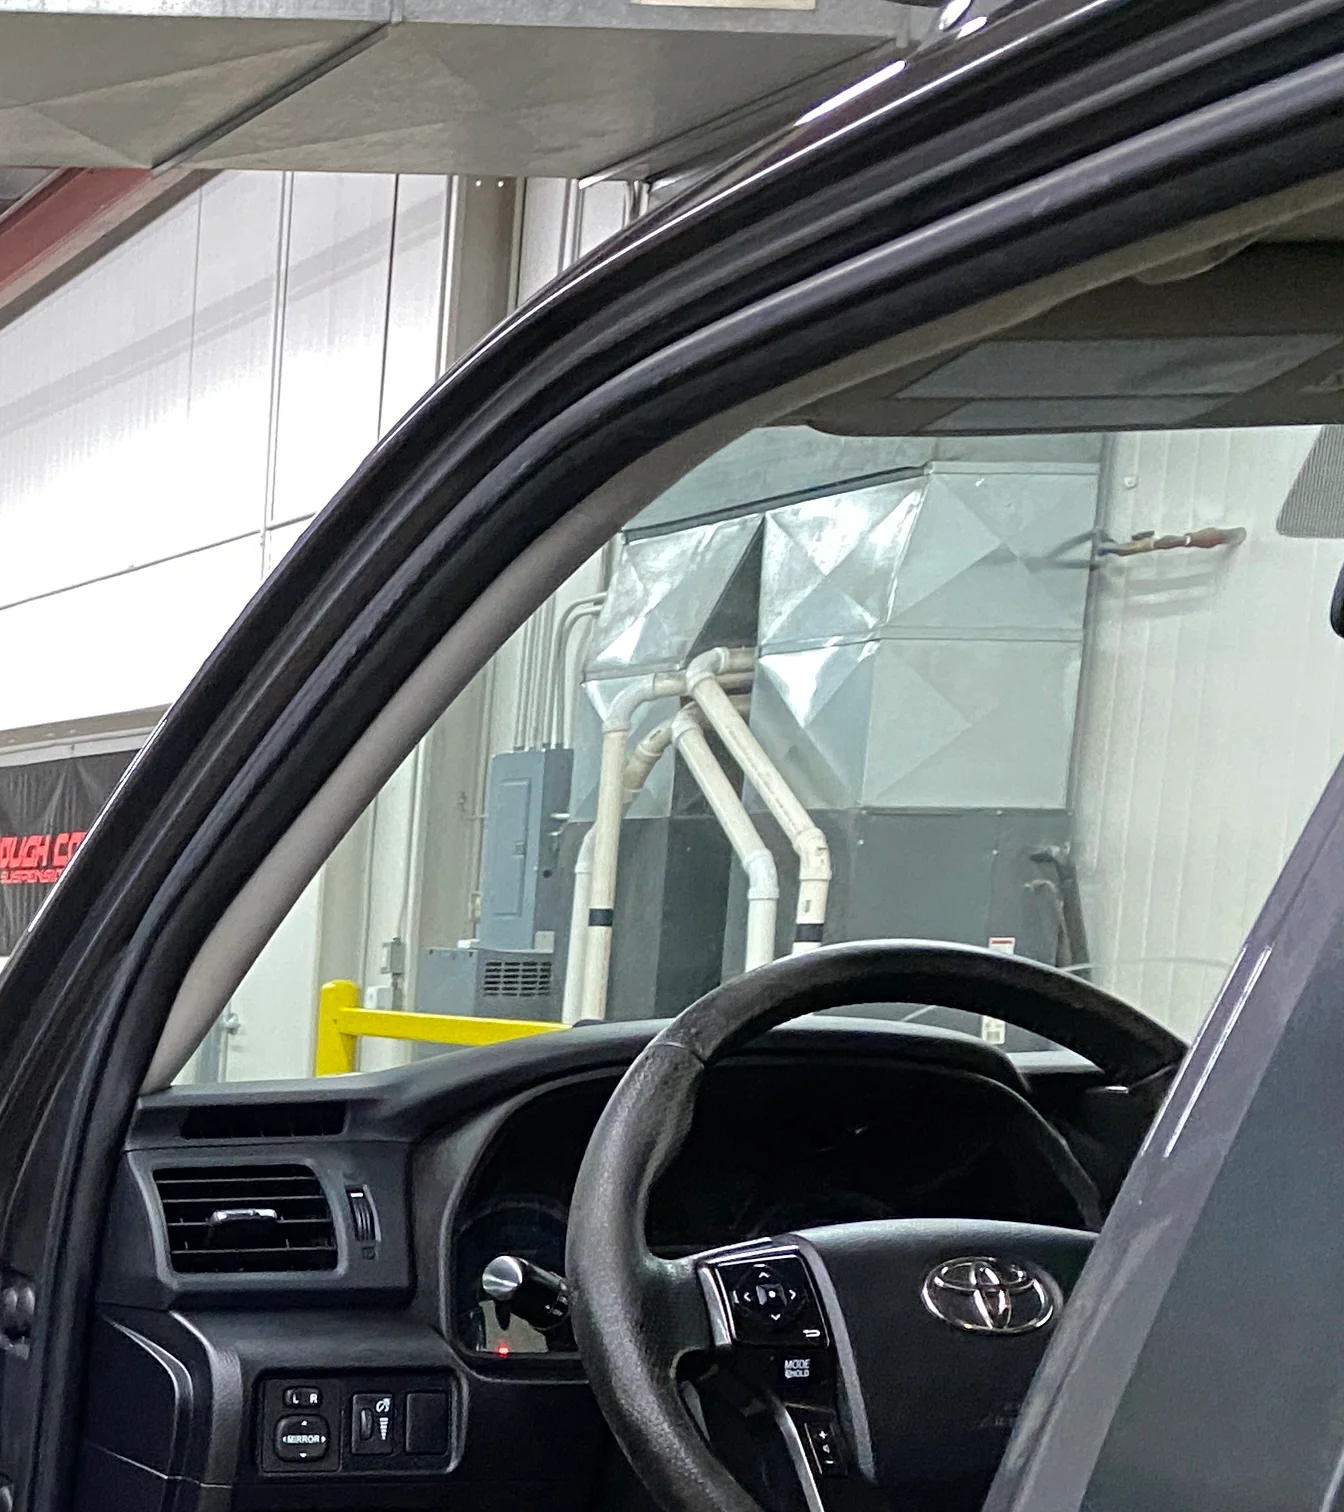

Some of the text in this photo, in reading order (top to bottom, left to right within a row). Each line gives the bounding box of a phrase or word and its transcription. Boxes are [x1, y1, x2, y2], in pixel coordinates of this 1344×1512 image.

[784, 1359, 811, 1369] MODE
[292, 1393, 317, 1404] L R
[287, 1434, 320, 1444] MIRROR
